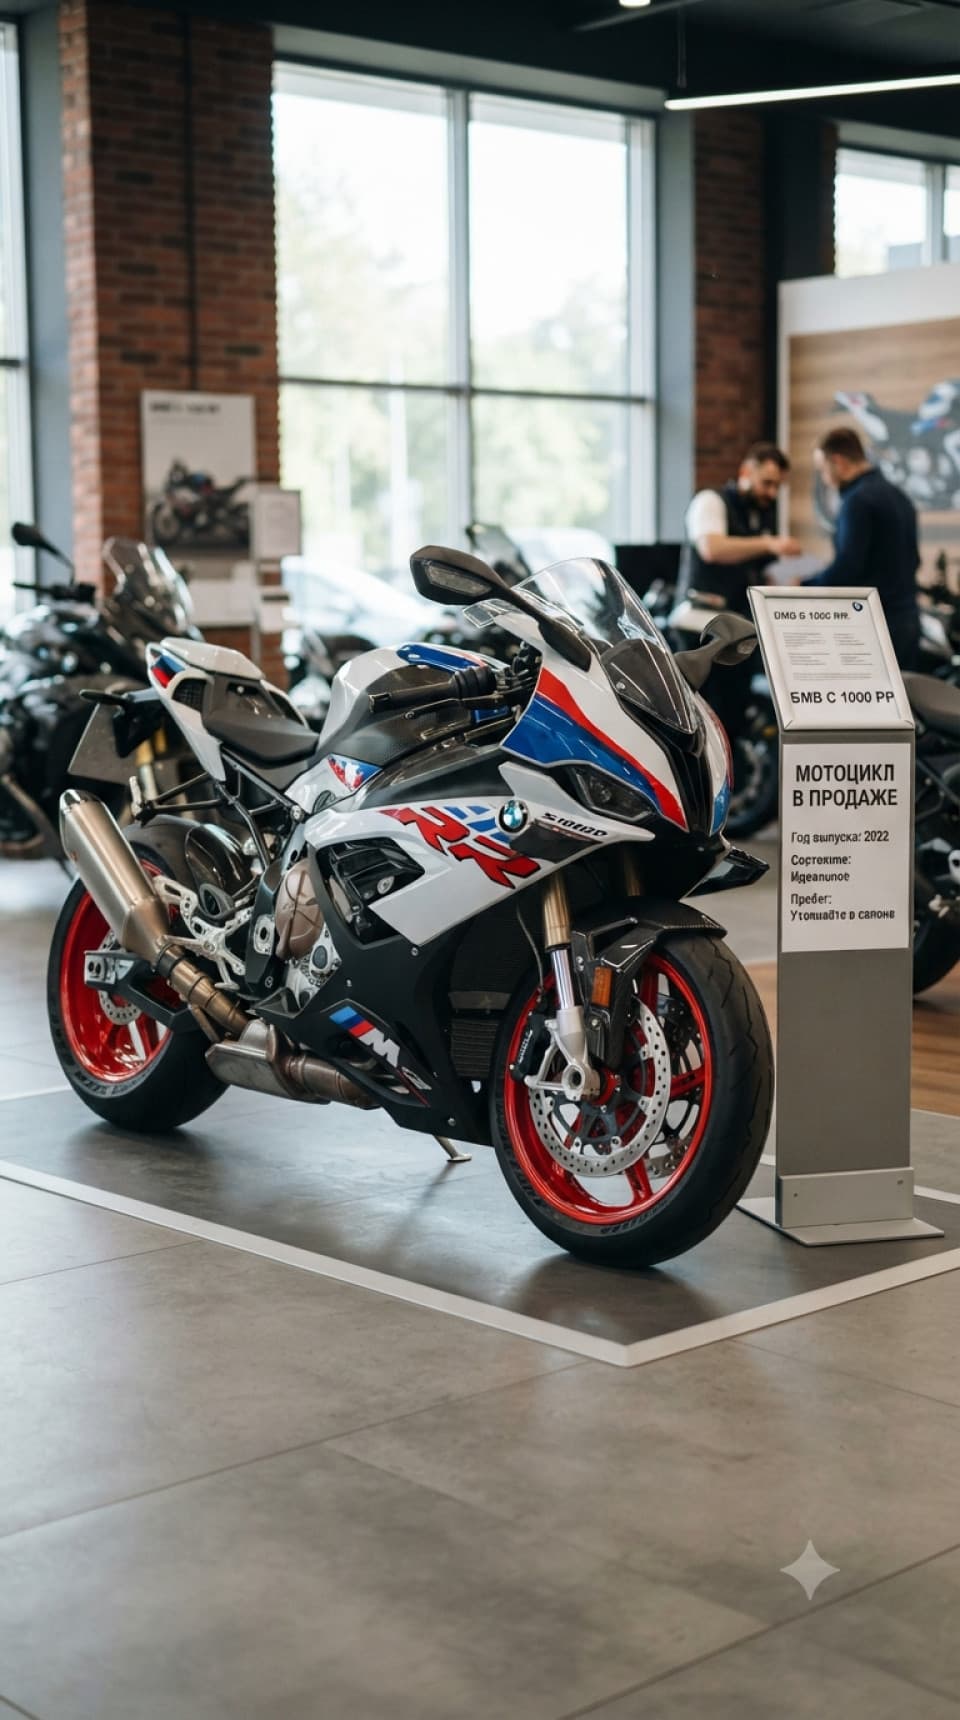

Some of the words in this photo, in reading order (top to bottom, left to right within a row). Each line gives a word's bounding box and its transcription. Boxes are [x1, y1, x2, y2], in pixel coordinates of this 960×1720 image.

[841, 692, 872, 704] 1000
[796, 764, 894, 784] МОТОЦИКЛ
[793, 789, 803, 806] В
[810, 789, 898, 809] ПРОДАЖЕ
[791, 832, 810, 844] Год
[864, 831, 889, 842] 2022
